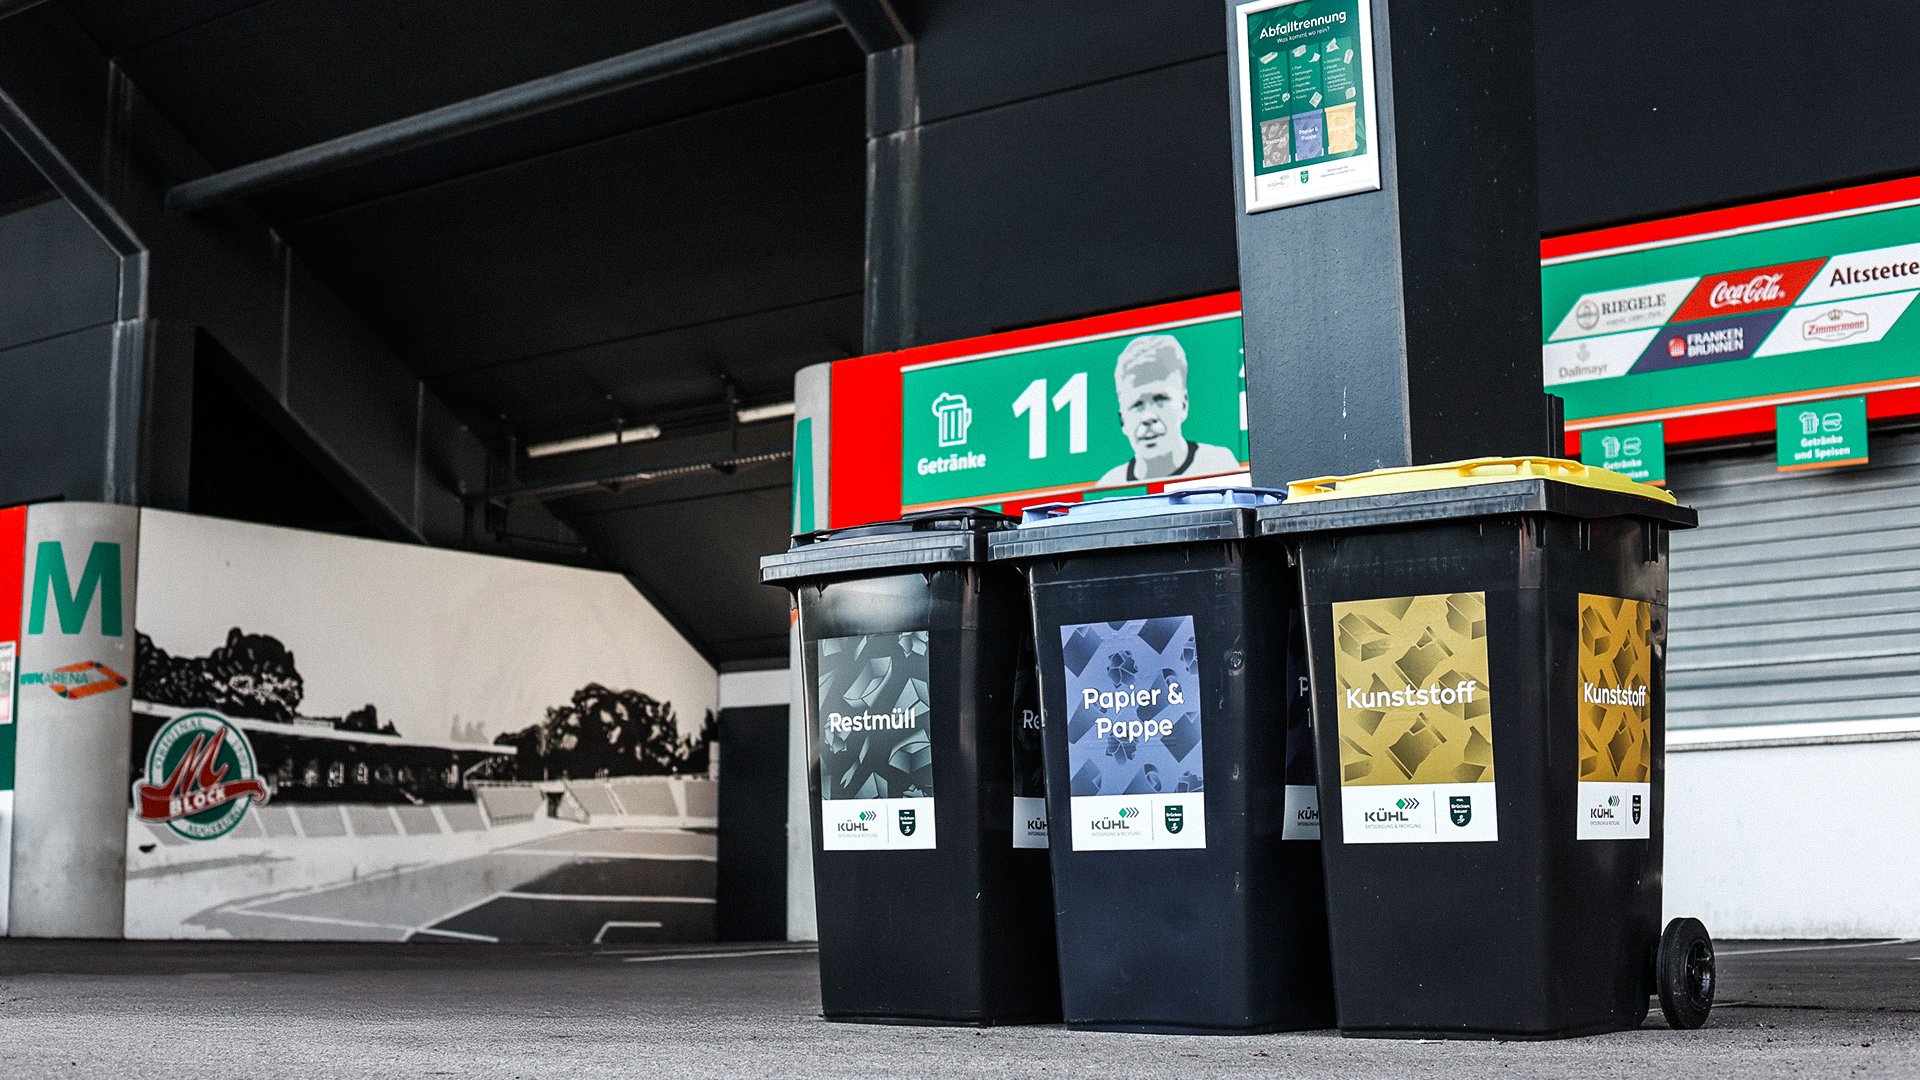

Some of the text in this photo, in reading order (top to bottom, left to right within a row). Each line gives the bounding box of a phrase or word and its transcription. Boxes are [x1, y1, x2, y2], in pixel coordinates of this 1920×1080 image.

[1260, 11, 1346, 39] Abfalltrennung
[1289, 32, 1307, 41] kommt
[1317, 26, 1330, 34] rein?
[1830, 261, 1920, 287] Altstette
[1602, 293, 1666, 315] RIEGELE
[1687, 327, 1743, 346] FRANKEN
[1688, 338, 1744, 358] BRUNNEN
[1559, 364, 1608, 378] Dallmayr
[1012, 372, 1089, 459] 11
[1800, 435, 1844, 448] Getränke
[917, 452, 987, 476] Getränke
[1794, 447, 1851, 461] und Speisen
[28, 541, 123, 637] M
[1082, 682, 1184, 713] Papier &
[1346, 680, 1477, 710] Kunststoff
[1584, 681, 1647, 708] Kunststoff
[830, 708, 917, 732] Restmüll
[1095, 717, 1173, 743] Pappe
[168, 784, 226, 818] BLOCK
[1590, 804, 1614, 819] KÜHL
[1027, 818, 1048, 830] KÜH
[1091, 816, 1129, 830] KÜHL
[1297, 807, 1319, 820] KÜH
[1364, 808, 1409, 822] KÜHL
[838, 820, 869, 831] KÜHL
